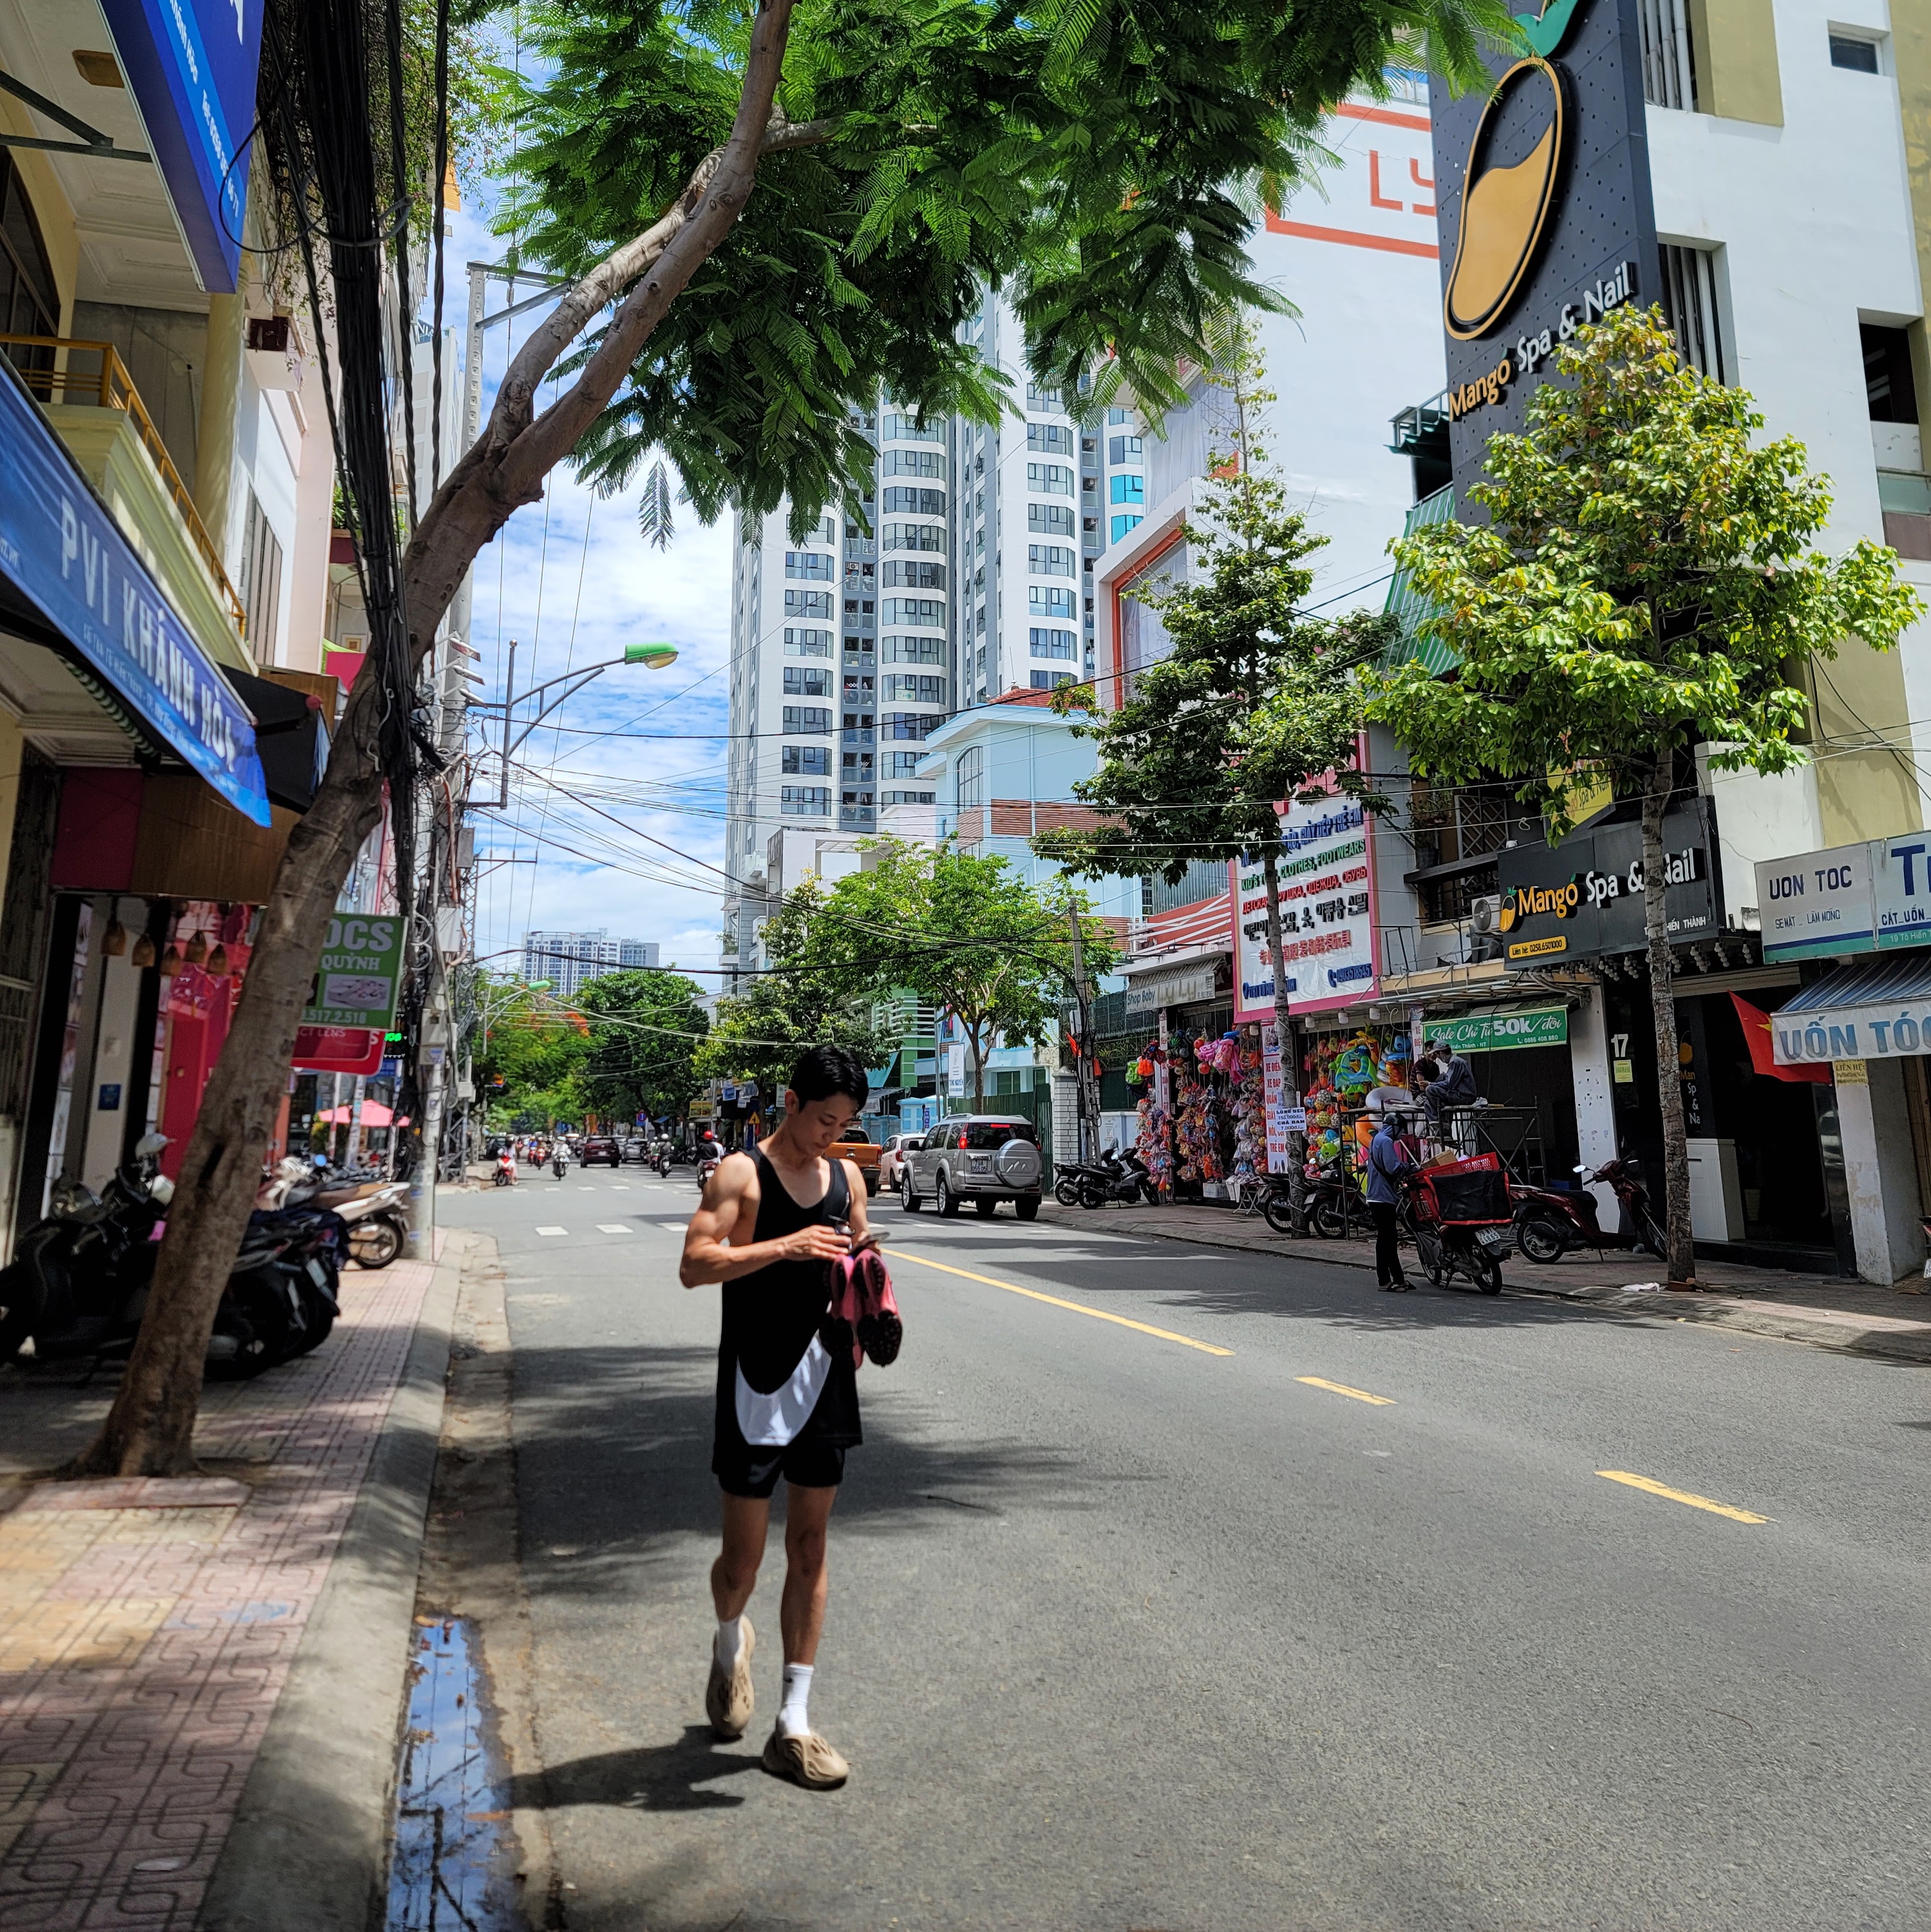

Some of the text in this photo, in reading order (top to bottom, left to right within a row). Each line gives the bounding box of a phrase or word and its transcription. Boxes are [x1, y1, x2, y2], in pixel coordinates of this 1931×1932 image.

[1449, 260, 1633, 422] Mango Spa & Nail
[61, 494, 110, 627] PVI
[122, 576, 196, 727] KHÁNH
[1241, 875, 1260, 891] KID'S
[1317, 838, 1366, 867] FOOTWEARS
[1518, 882, 1578, 919] Mango
[1585, 870, 1619, 909] Spa
[1627, 860, 1646, 893] &
[1769, 865, 1852, 900] UON TOC
[1682, 915, 1707, 929] THÀNH
[1890, 934, 1899, 943] 19
[1127, 987, 1156, 1006] Shop Baby
[1430, 1025, 1456, 1042] Sale
[1779, 1015, 1859, 1060] UỐN
[1610, 1033, 1629, 1058] 17
[1265, 1063, 1271, 1072] XE
[1680, 1069, 1696, 1080] Man
[1267, 1078, 1272, 1088] XE
[1687, 1082, 1697, 1096] Sp
[1688, 1112, 1700, 1124] Na
